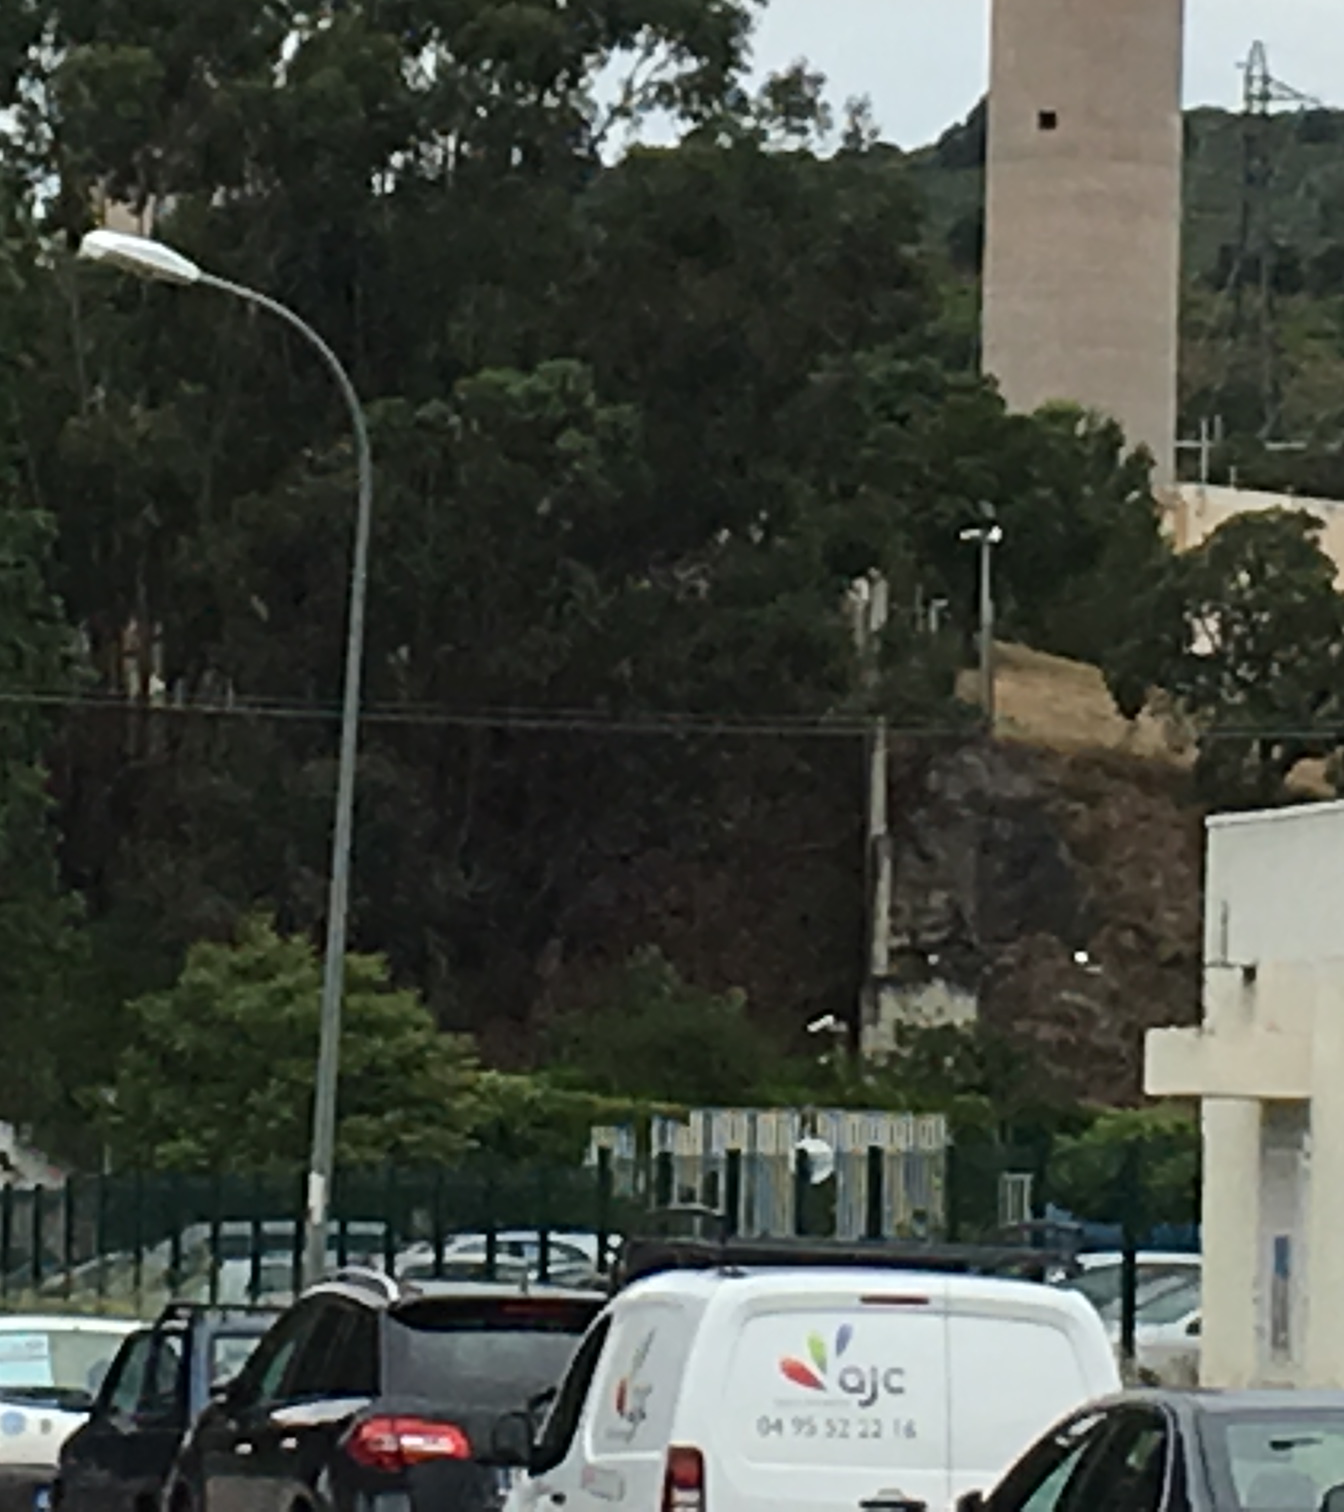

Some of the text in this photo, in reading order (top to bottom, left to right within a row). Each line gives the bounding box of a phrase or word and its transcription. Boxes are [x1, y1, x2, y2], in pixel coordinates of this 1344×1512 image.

[837, 1365, 906, 1409] ajc
[756, 1414, 783, 1437] 04
[791, 1415, 818, 1437] 95
[825, 1417, 850, 1438] 52
[857, 1417, 883, 1439] 22
